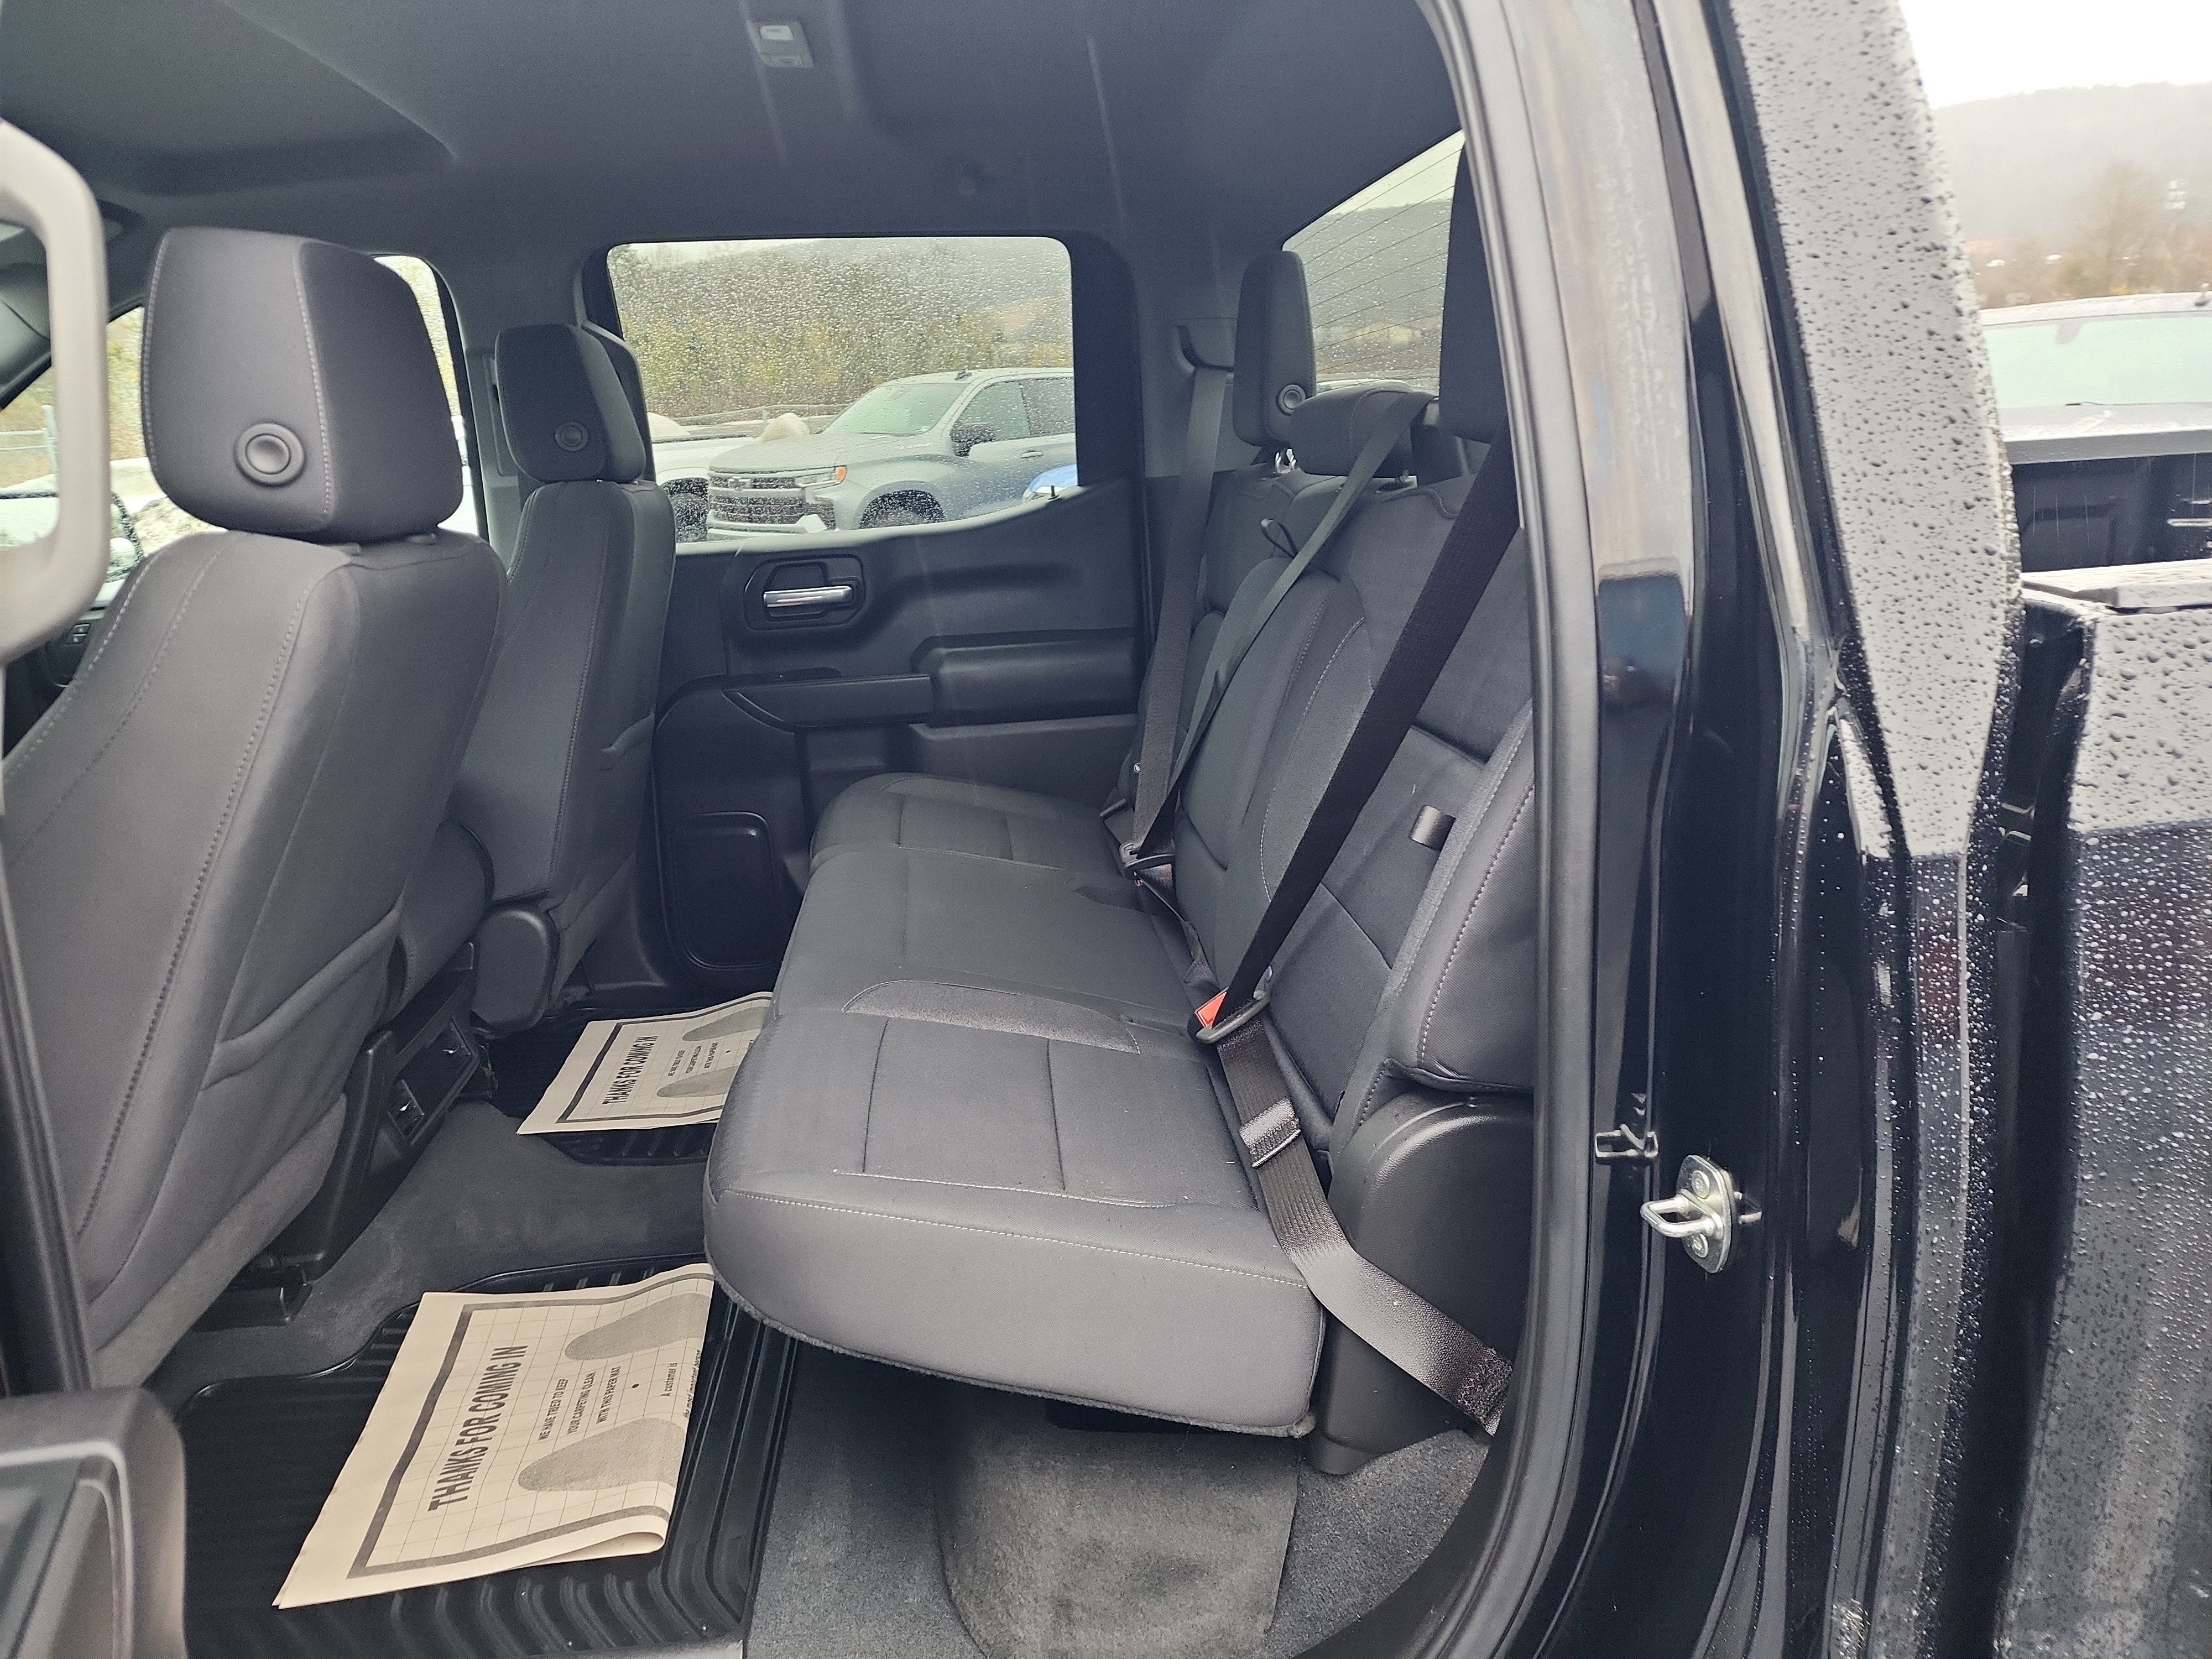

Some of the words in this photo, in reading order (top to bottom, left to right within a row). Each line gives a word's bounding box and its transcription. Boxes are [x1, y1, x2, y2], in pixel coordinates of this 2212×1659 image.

[623, 1042, 655, 1065] COMING
[616, 1065, 644, 1078] FOR
[602, 1079, 637, 1104] THANKS
[490, 1345, 528, 1360] IN
[582, 1371, 596, 1389] CLEAN
[609, 1366, 620, 1378] MAT
[664, 1368, 676, 1391] customer
[468, 1362, 521, 1412] COMING
[555, 1379, 568, 1391] KEEP
[604, 1376, 618, 1395] PAPER
[547, 1399, 561, 1416] TRIED
[572, 1389, 591, 1418] CARPETING
[601, 1394, 613, 1408] THIS
[541, 1416, 556, 1430] HAVE
[596, 1407, 609, 1424] WITH
[455, 1412, 501, 1446] FOR
[566, 1418, 581, 1435] YOUR
[538, 1430, 550, 1441] WE
[427, 1446, 488, 1511] THANKS
